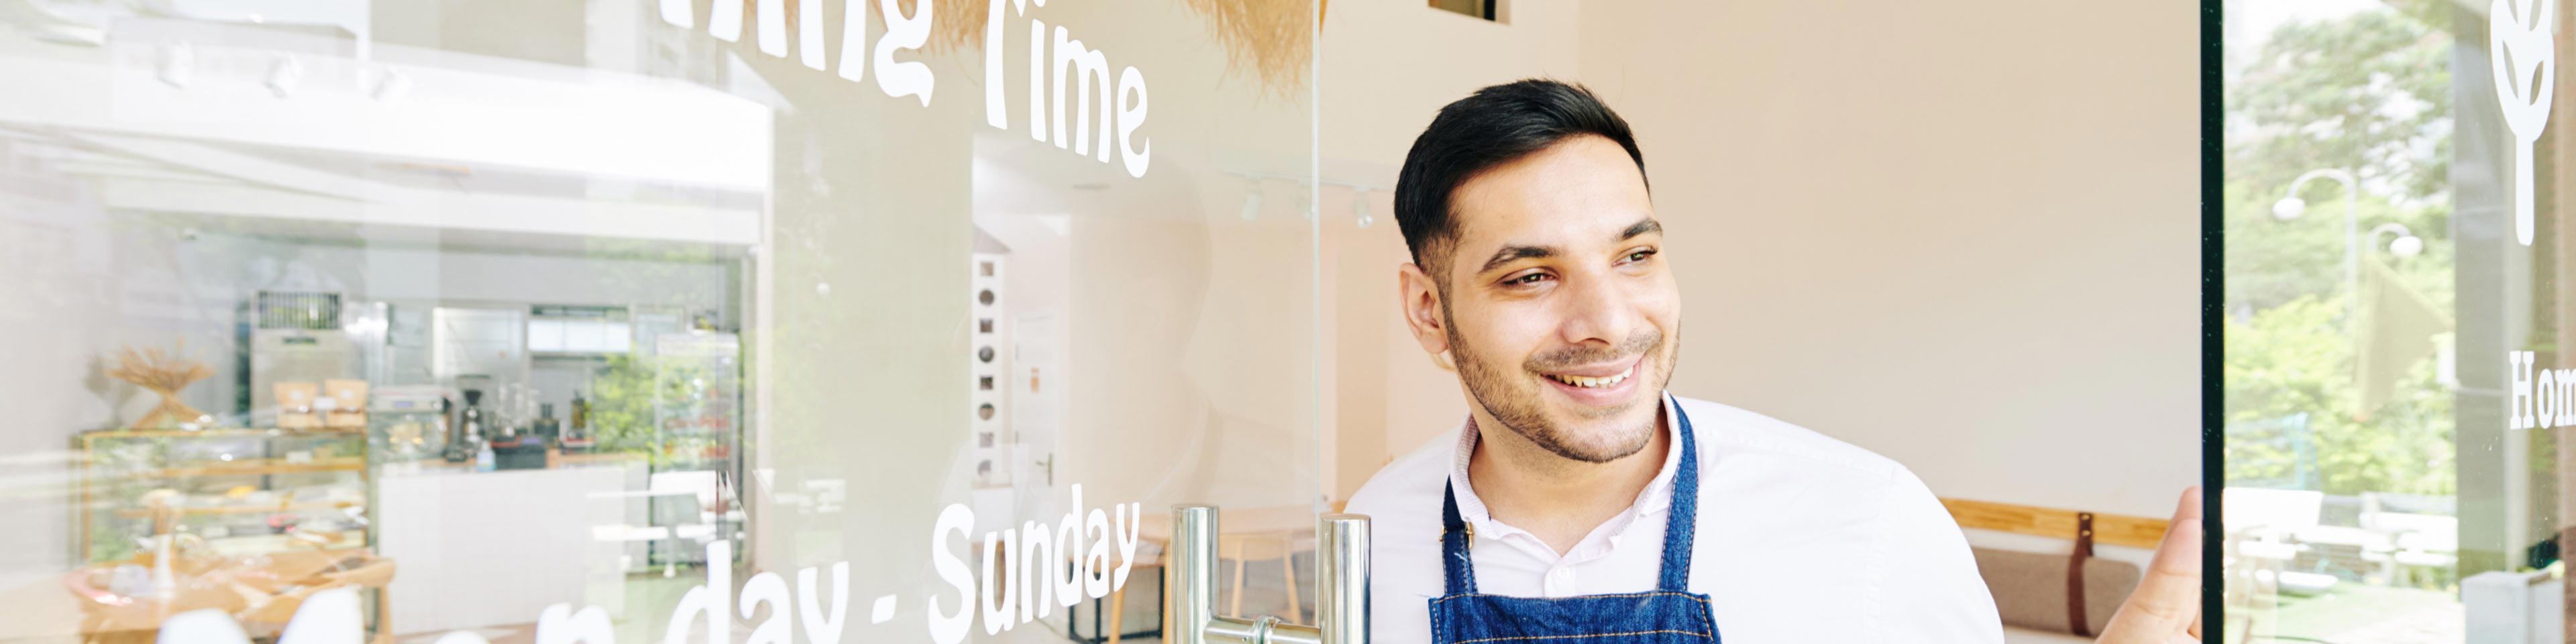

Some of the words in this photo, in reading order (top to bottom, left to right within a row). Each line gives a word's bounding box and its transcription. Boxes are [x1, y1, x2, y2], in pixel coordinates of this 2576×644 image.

[985, 0, 1150, 178] Time
[2509, 350, 2576, 429] Hom
[157, 539, 849, 644] day
[928, 483, 1140, 644] Sunday
